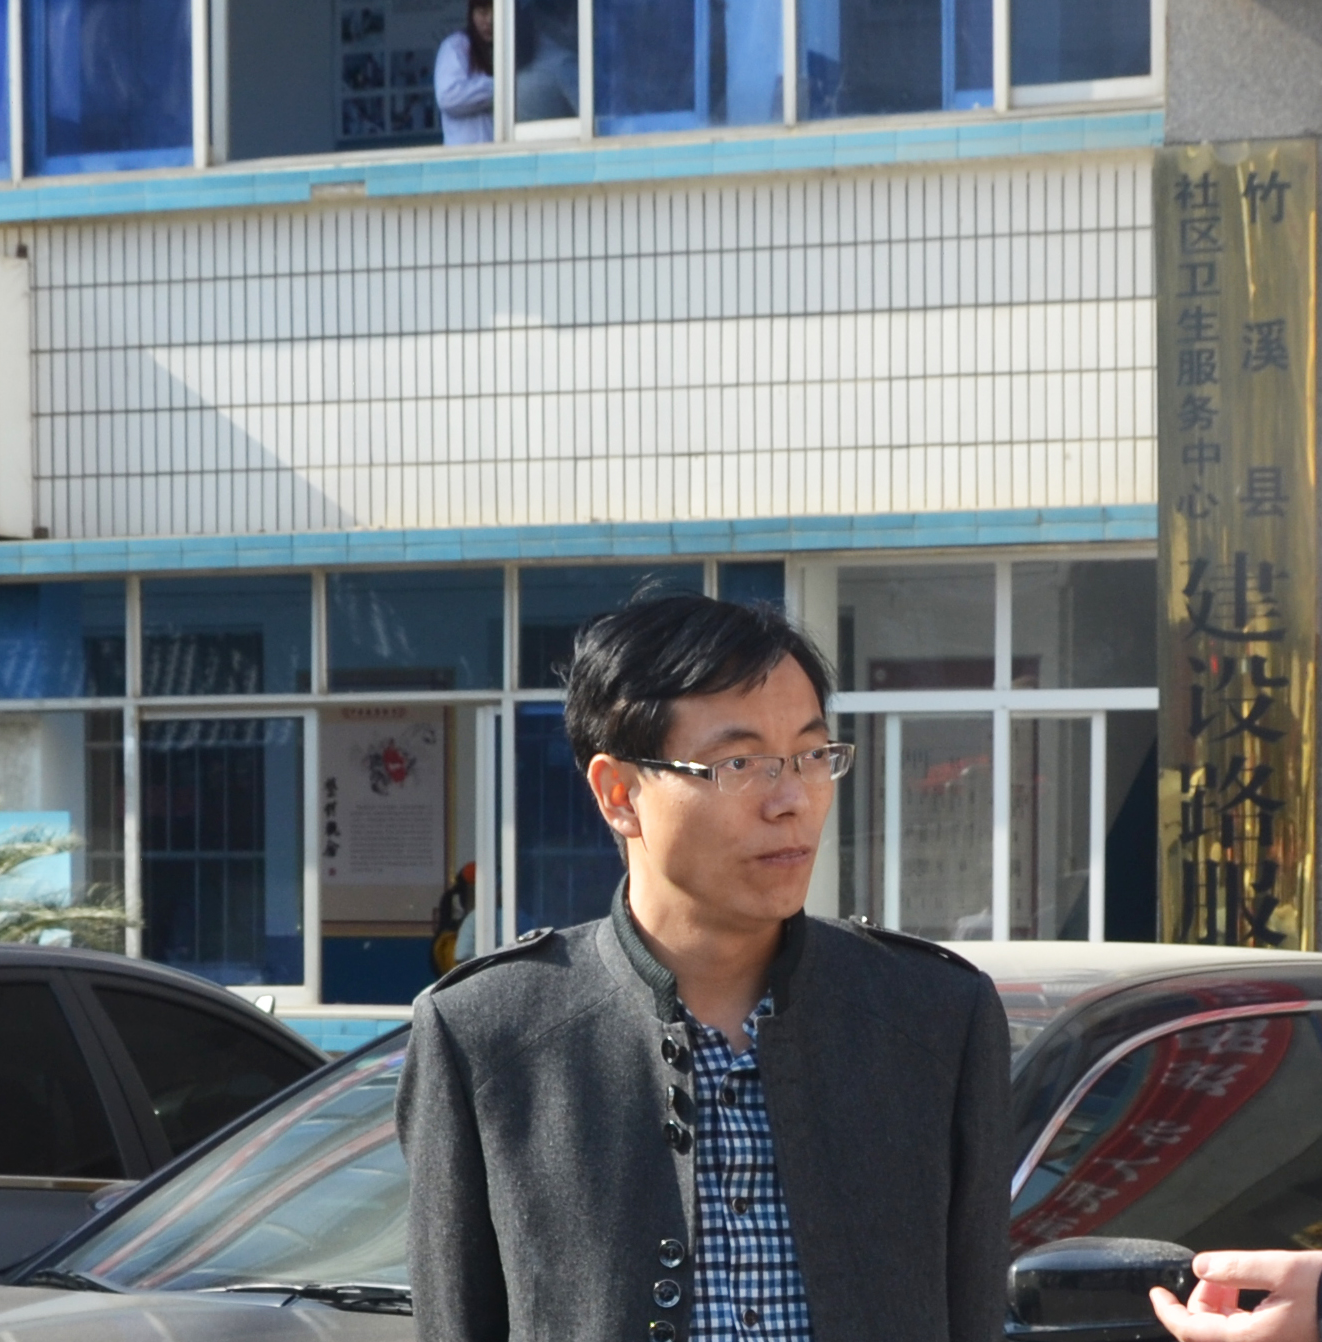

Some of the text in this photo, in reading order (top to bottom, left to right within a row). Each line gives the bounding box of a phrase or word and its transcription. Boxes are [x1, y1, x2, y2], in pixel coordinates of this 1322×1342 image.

[1174, 171, 1223, 520] 社区卫生服务中心
